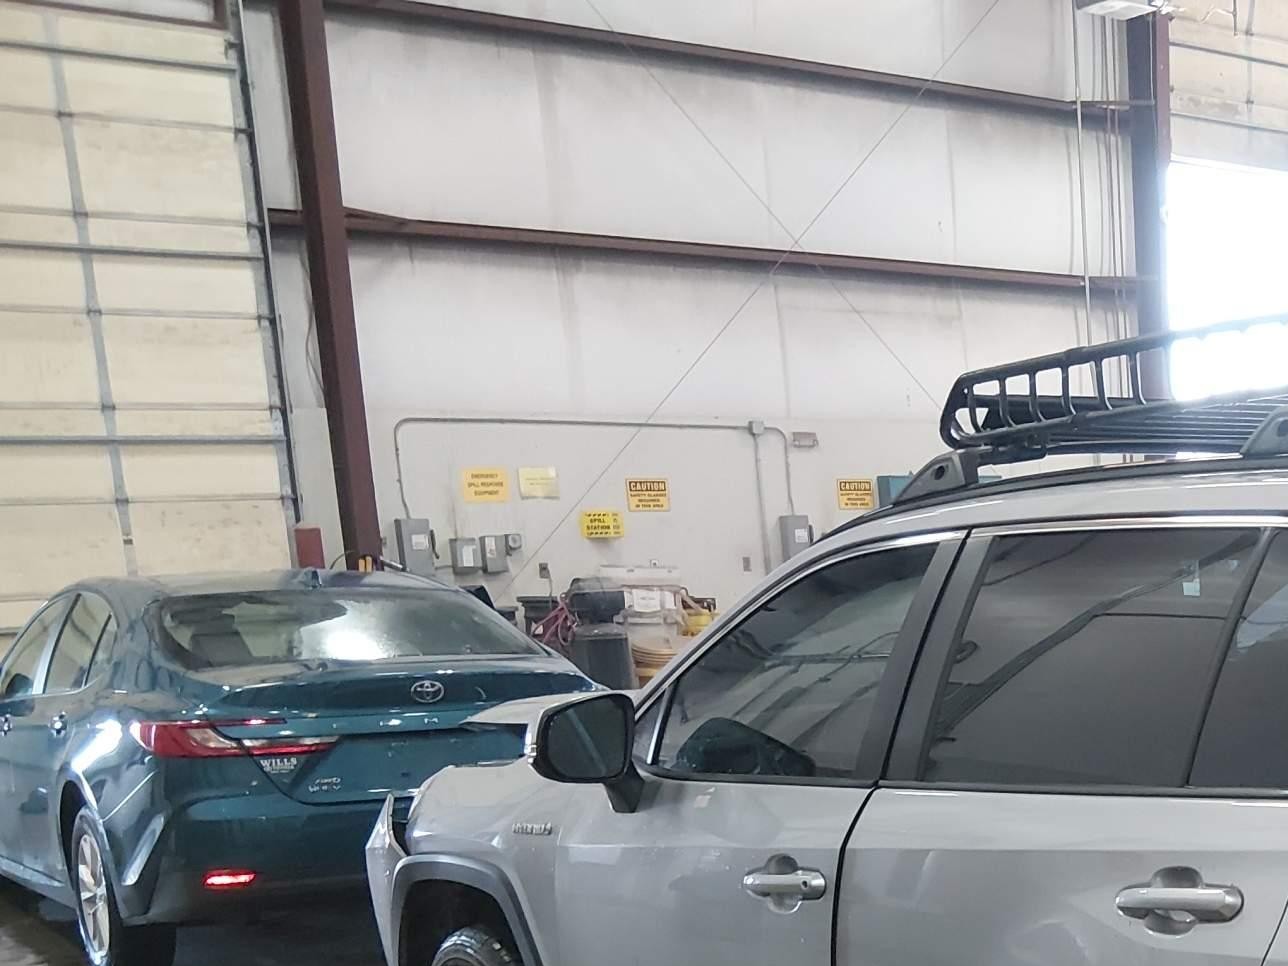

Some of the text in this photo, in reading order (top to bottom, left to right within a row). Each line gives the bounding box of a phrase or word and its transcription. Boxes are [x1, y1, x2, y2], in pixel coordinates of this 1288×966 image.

[630, 482, 666, 491] CAUTION
[840, 482, 870, 491] CAUTION
[260, 757, 298, 767] WILLS
